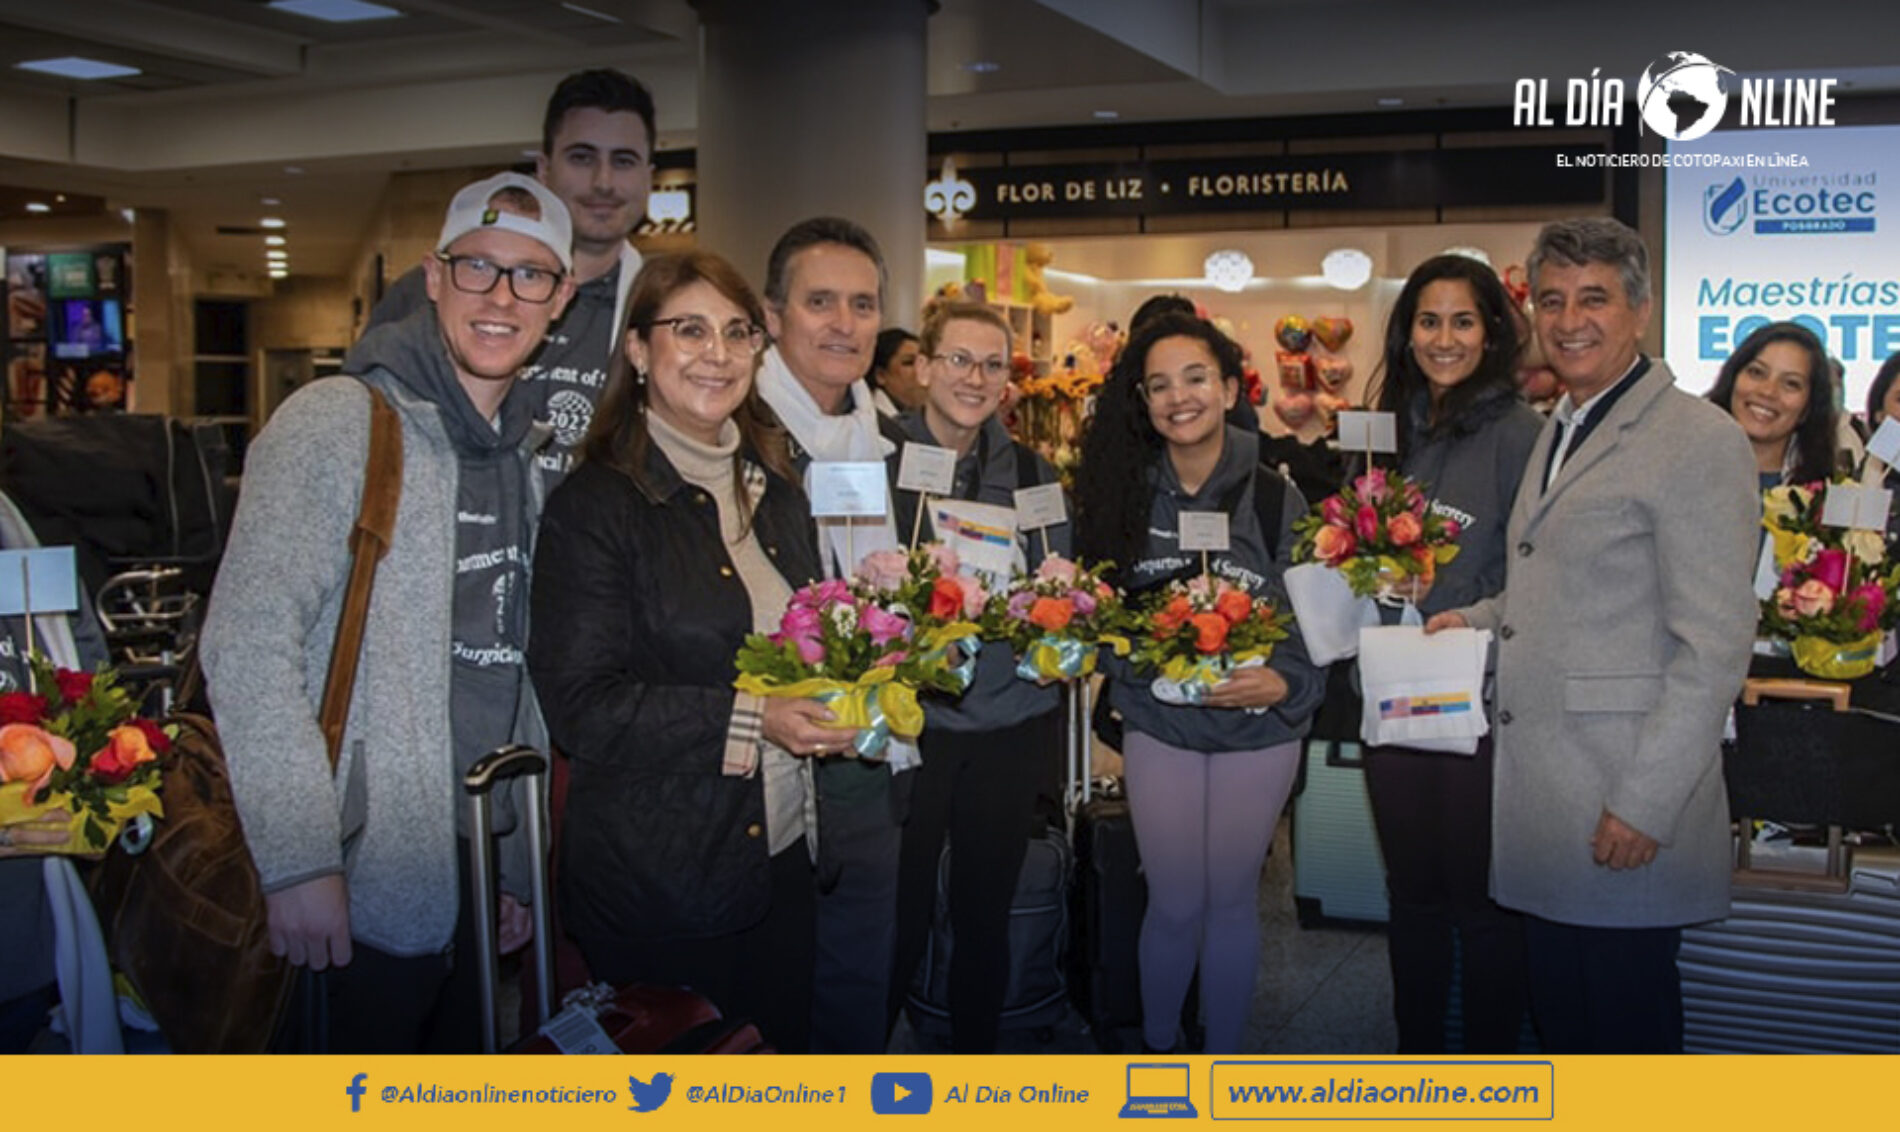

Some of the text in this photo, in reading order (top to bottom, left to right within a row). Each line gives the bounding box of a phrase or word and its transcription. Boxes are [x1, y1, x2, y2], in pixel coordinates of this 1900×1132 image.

[997, 169, 1348, 203] FLOR DE LIZ FLORISTERÍA
[1752, 171, 1877, 187] Universidad
[1753, 188, 1876, 215] Ecotec
[1698, 272, 1900, 306] Maestrías
[547, 409, 592, 432] 2022
